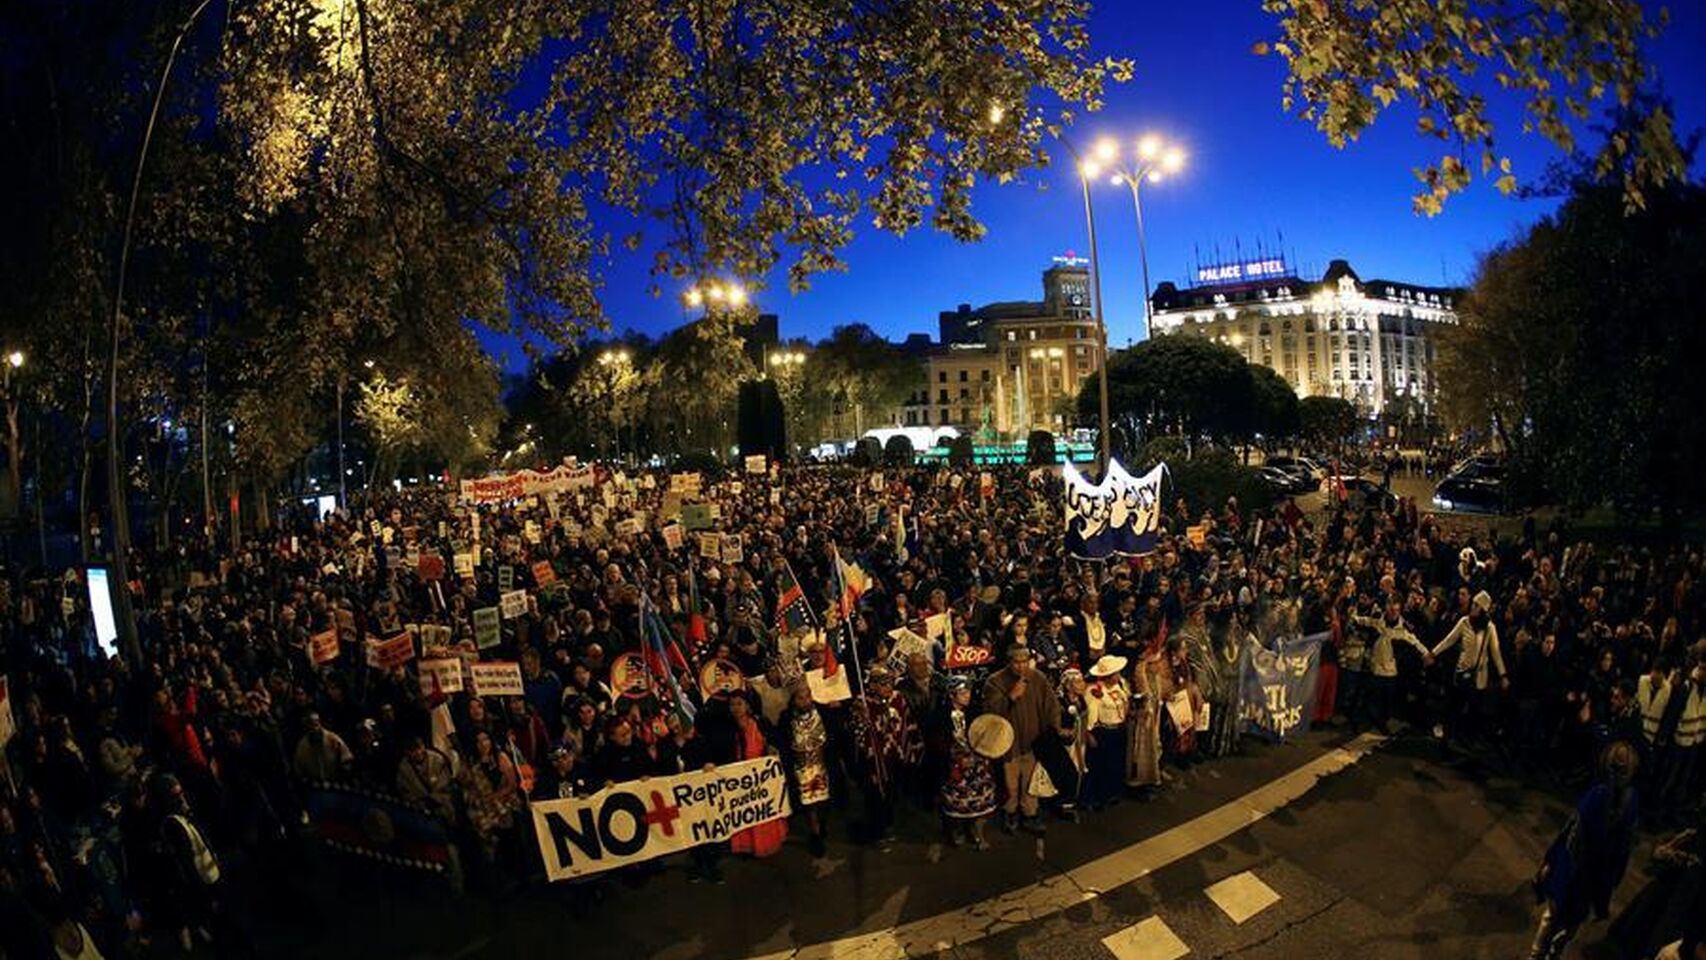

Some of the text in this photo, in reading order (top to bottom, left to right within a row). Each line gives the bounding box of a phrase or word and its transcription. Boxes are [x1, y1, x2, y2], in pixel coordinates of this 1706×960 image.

[1199, 260, 1284, 281] PALACE HOTEL
[672, 759, 783, 807] Represión
[718, 787, 769, 813] y pueblo
